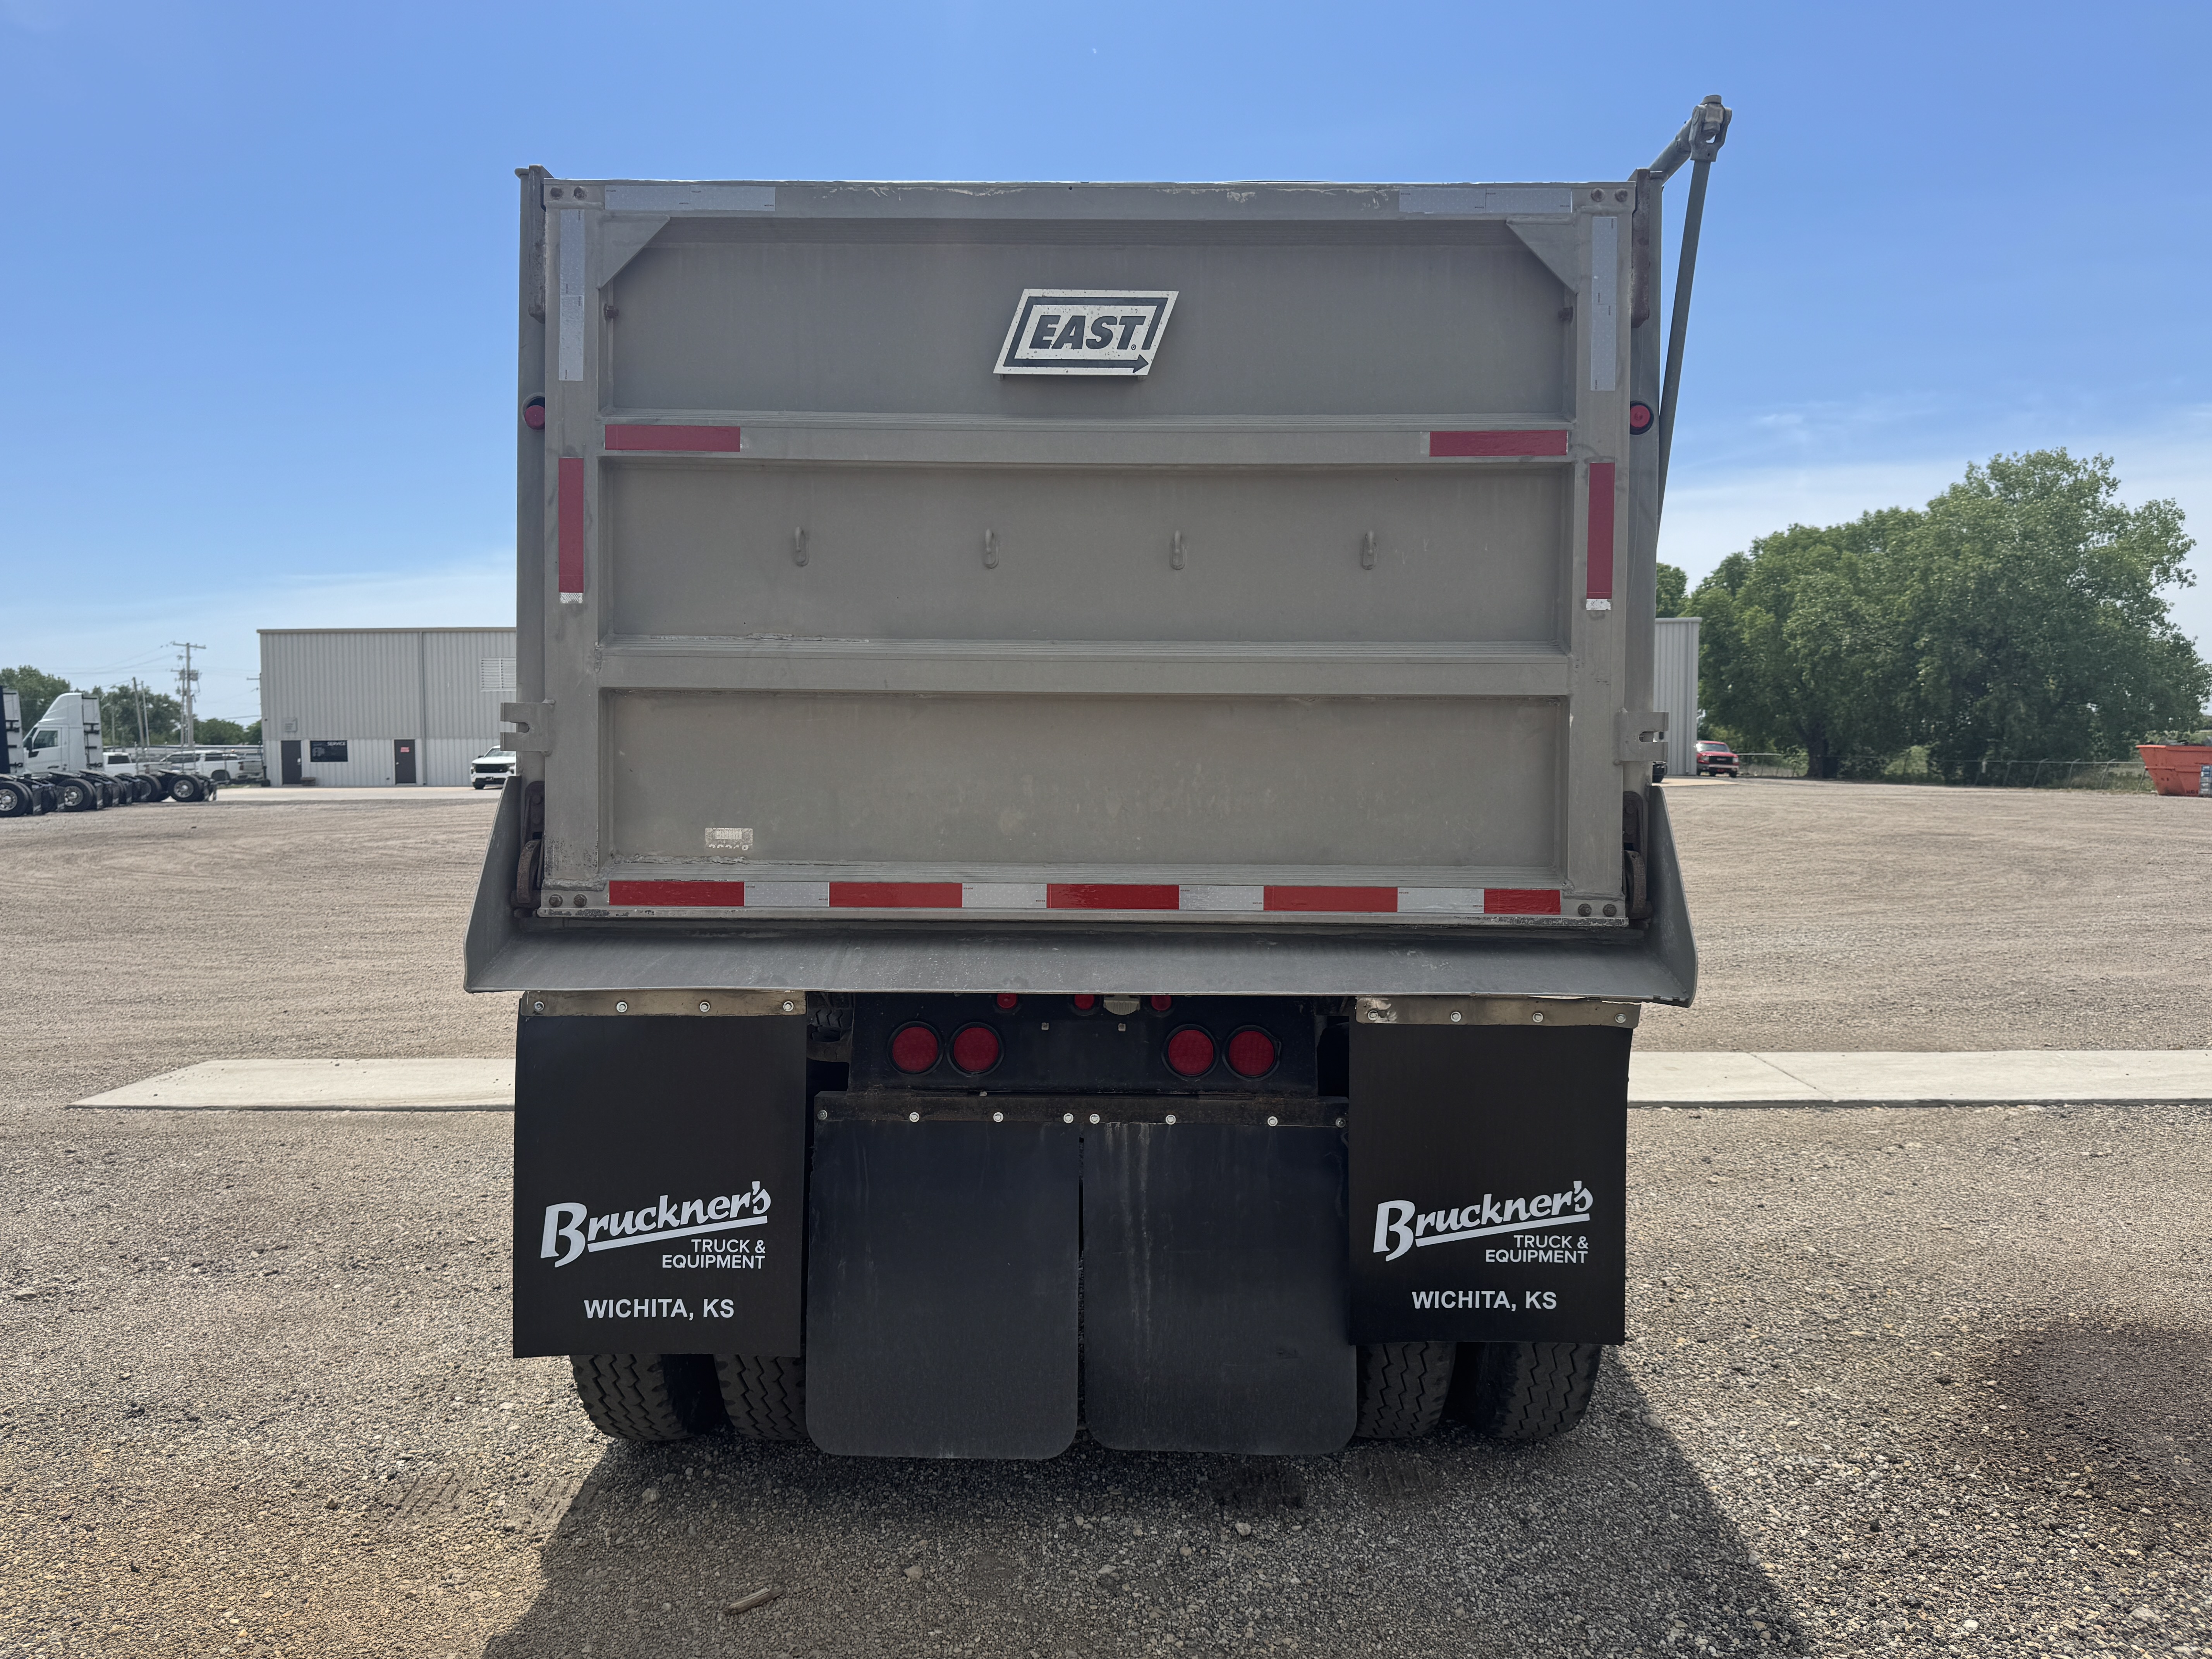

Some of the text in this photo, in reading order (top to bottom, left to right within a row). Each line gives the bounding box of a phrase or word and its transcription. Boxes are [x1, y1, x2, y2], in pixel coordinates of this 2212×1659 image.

[1029, 315, 1146, 350] EAST
[540, 1181, 771, 1268] Bruckner's
[1373, 1180, 1593, 1262] Bruckner's
[691, 1239, 766, 1254] TRUCK &
[1513, 1235, 1589, 1249] TRUCK &
[662, 1254, 765, 1269] EQUIPMENT
[1486, 1249, 1588, 1264] EQUIPMENT
[584, 1298, 734, 1321] WICHITA, KS
[1412, 1290, 1557, 1312] WICHITA, KS
